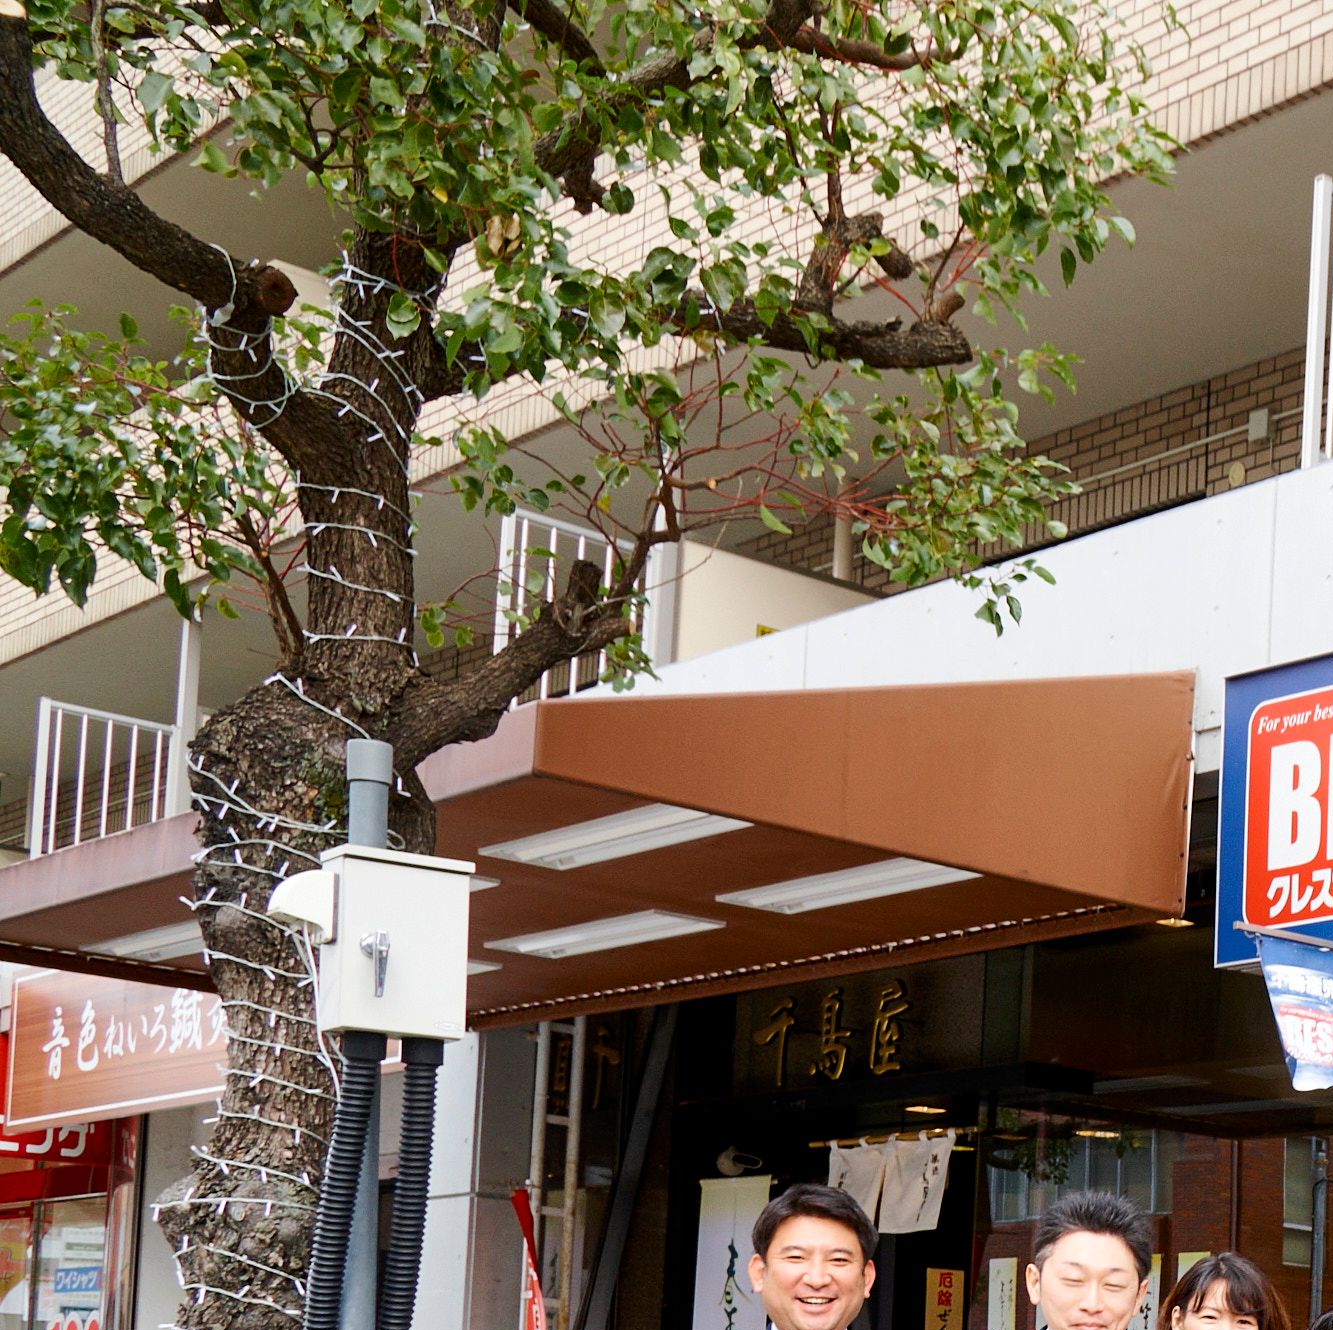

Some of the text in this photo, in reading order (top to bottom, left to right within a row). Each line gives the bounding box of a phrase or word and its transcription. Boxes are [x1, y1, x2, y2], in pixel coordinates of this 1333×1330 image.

[1257, 715, 1279, 735] For
[1280, 712, 1312, 733] your
[752, 978, 909, 1087] 千鳥屋
[55, 1270, 98, 1291] ワイシャツ
